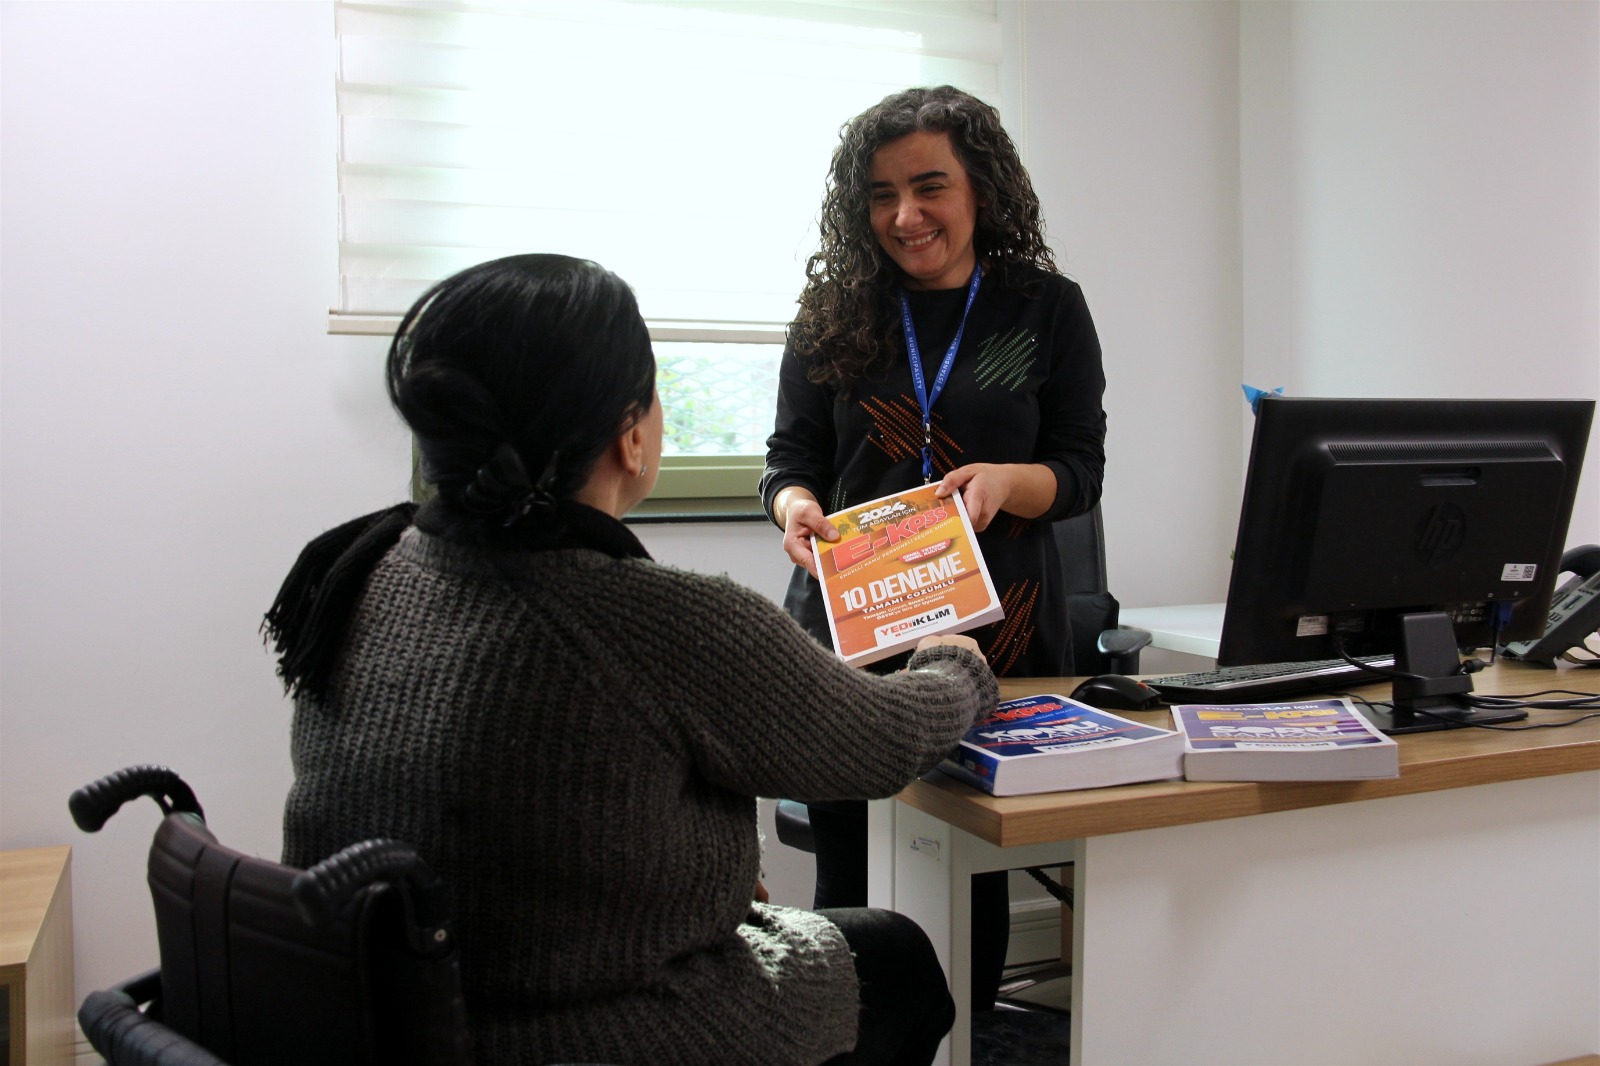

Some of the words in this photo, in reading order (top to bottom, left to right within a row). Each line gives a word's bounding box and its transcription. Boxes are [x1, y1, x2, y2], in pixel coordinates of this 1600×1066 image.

[909, 337, 922, 389] MUNICIPALITY
[858, 501, 907, 524] 2024
[868, 511, 902, 527] ADAYLAR
[832, 506, 948, 572] E-KPSS
[864, 556, 881, 566] KAMU
[840, 586, 867, 612] 10
[868, 551, 967, 603] DENEME
[863, 597, 904, 614] TAMAMI
[978, 720, 1100, 739] KONU
